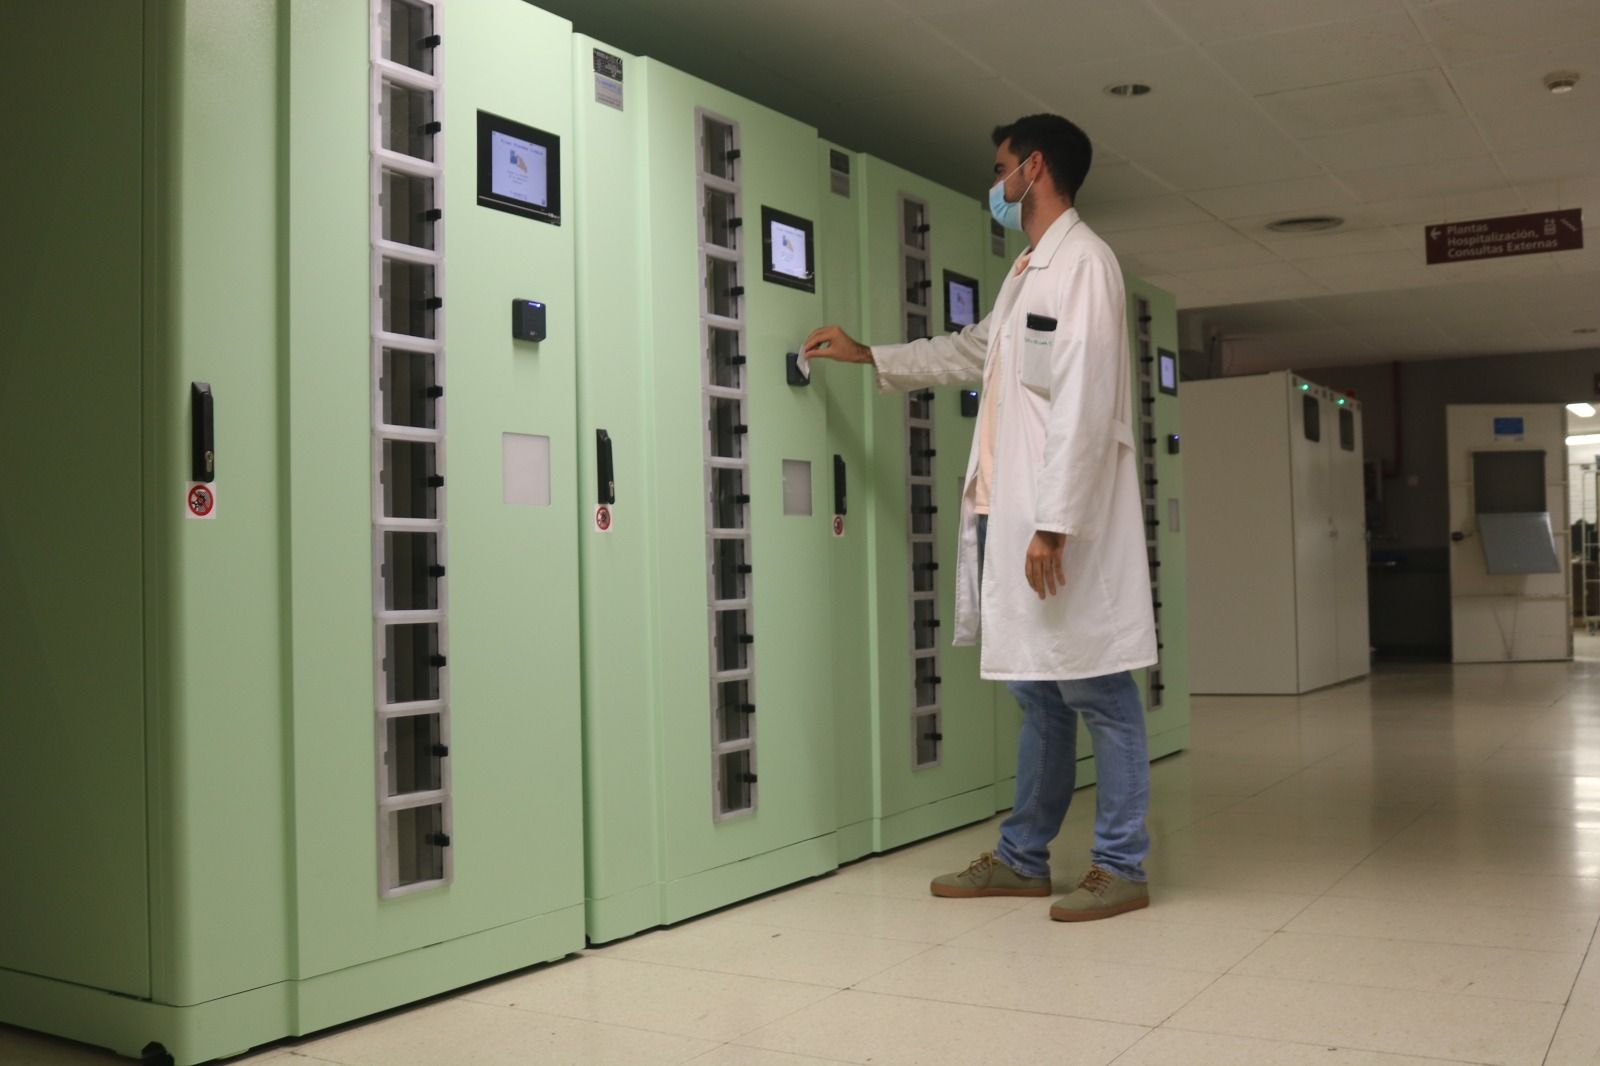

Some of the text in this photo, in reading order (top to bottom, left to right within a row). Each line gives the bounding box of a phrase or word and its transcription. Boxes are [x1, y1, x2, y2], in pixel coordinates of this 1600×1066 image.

[1447, 223, 1489, 234] Plantas
[1447, 229, 1539, 247] Hospitalización,
[1447, 238, 1558, 258] Consultas Externas
